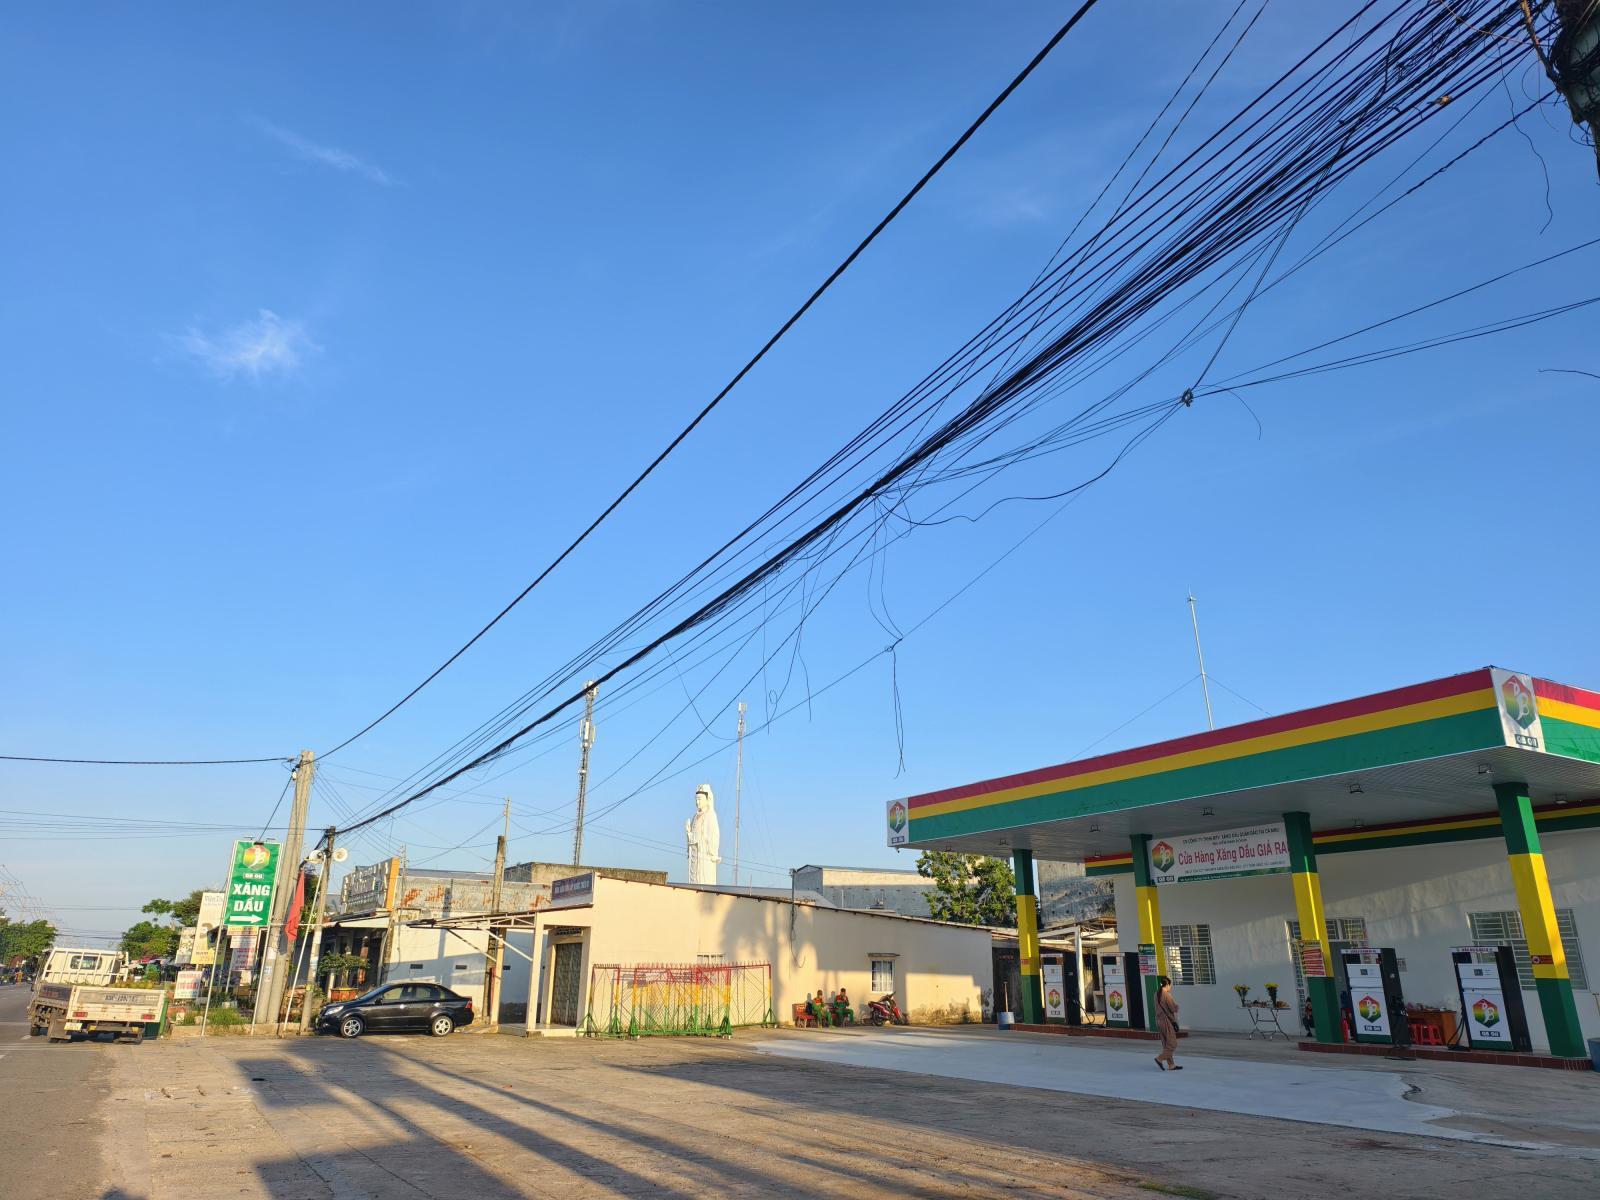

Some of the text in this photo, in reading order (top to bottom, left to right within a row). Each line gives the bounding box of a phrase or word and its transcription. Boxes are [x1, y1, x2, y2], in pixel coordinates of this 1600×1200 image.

[1178, 851, 1193, 865] Cửa
[1194, 850, 1215, 865] Hàng
[1216, 847, 1237, 863] Xăng
[232, 882, 271, 896] XĂNG
